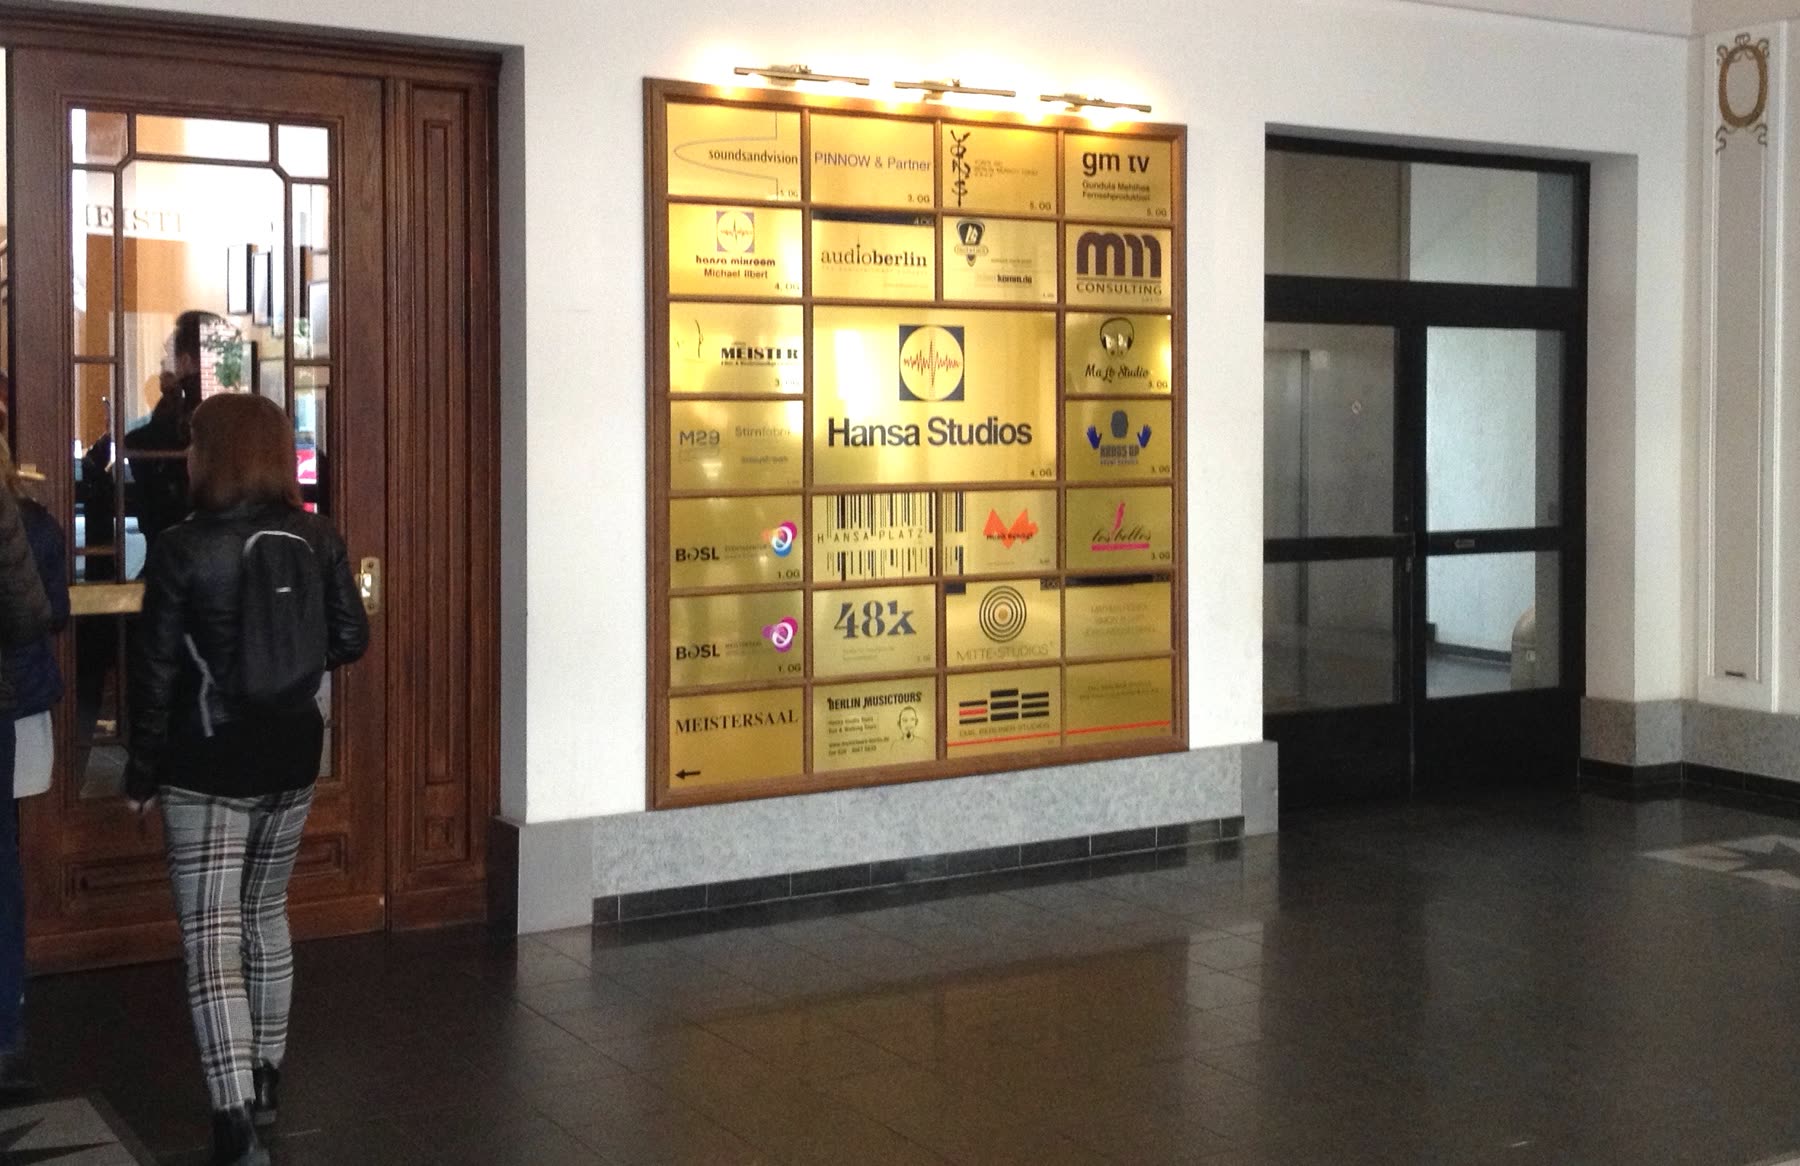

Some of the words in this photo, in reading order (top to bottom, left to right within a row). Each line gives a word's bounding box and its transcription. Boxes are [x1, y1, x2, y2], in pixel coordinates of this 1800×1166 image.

[708, 149, 798, 165] soundsandvision
[814, 152, 870, 168] PINNOW
[874, 155, 883, 168] &
[887, 156, 930, 171] Partner
[1082, 152, 1120, 177] gm
[821, 244, 927, 267] audioberlin
[703, 268, 740, 278] Michael
[743, 269, 768, 279] Ilbert
[1076, 283, 1162, 295] CONSULTING
[679, 429, 720, 446] M29
[828, 417, 920, 447] Hansa
[927, 416, 1033, 446] Studios
[833, 600, 917, 640] 48k
[827, 697, 861, 711] BERLIN
[862, 691, 922, 709] MUSICTOURS
[675, 709, 799, 734] MEISTERSAAL
